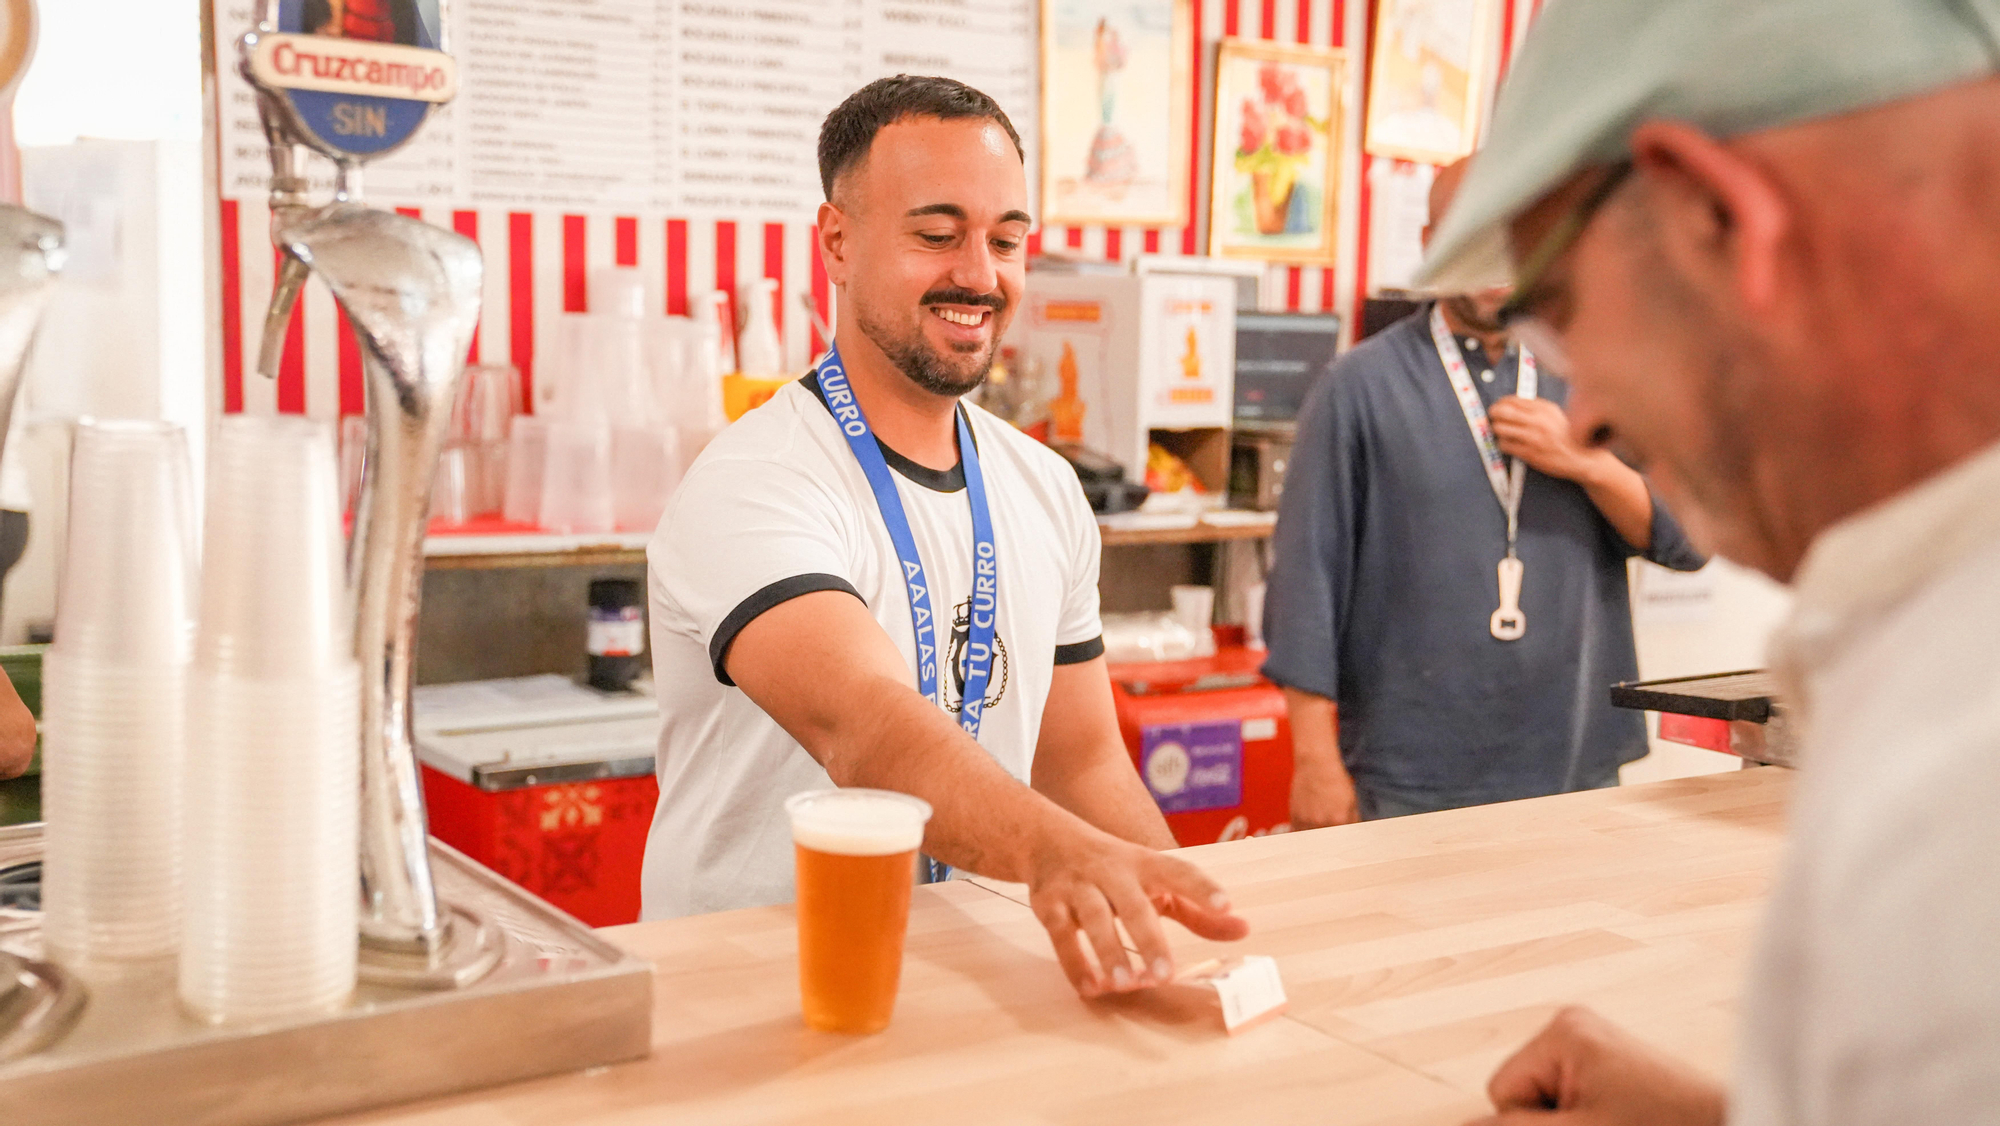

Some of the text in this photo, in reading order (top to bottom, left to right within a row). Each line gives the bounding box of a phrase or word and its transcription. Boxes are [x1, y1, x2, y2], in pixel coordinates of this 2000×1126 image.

[272, 41, 447, 94] Cruzcampo
[332, 102, 387, 138] SIN
[819, 365, 867, 437] CURRO
[973, 541, 995, 629] CURRO
[903, 560, 936, 682] AAALAS
[968, 642, 990, 680] TU
